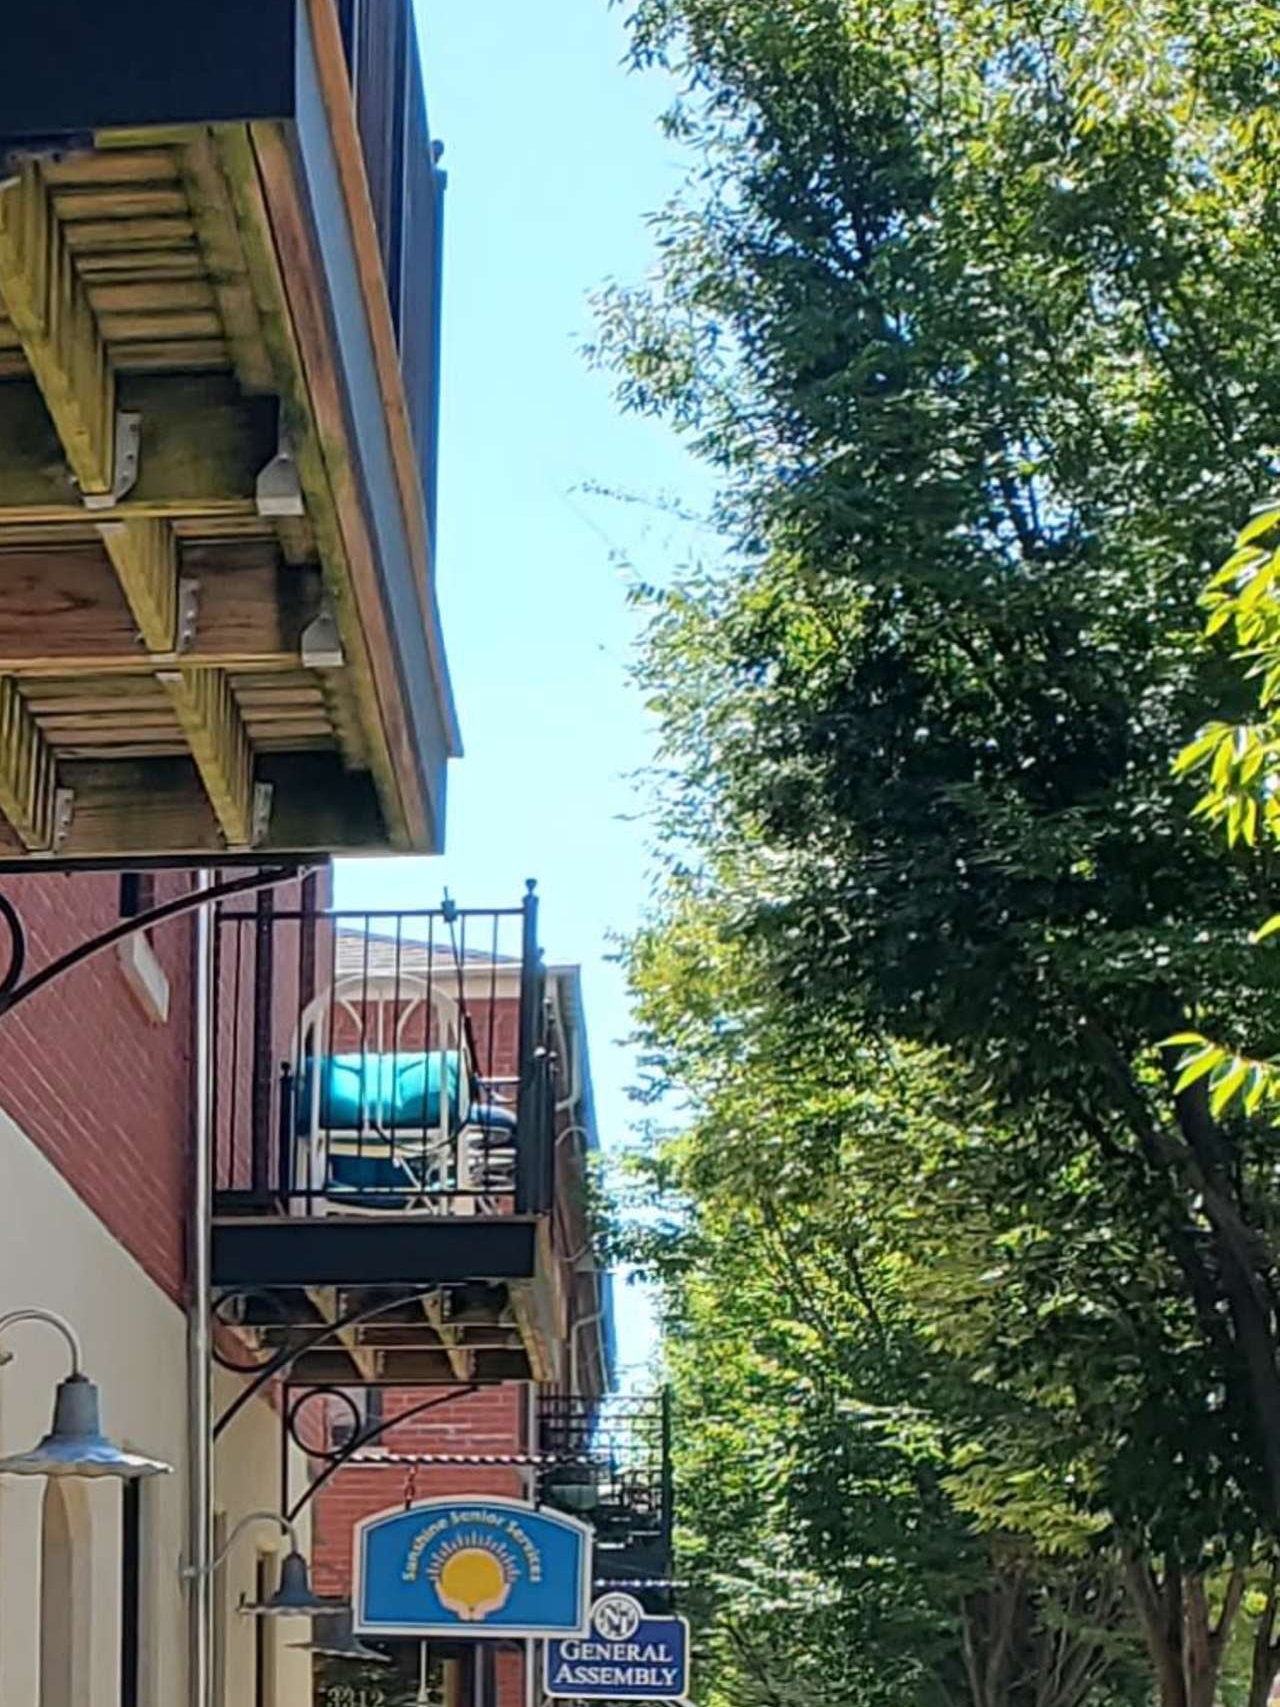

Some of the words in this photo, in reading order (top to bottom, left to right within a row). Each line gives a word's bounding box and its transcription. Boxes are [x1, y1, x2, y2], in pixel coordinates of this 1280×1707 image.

[448, 1510, 503, 1526] Senior
[559, 1640, 673, 1662] GENERAL
[553, 1663, 678, 1686] ASSEMBLY
